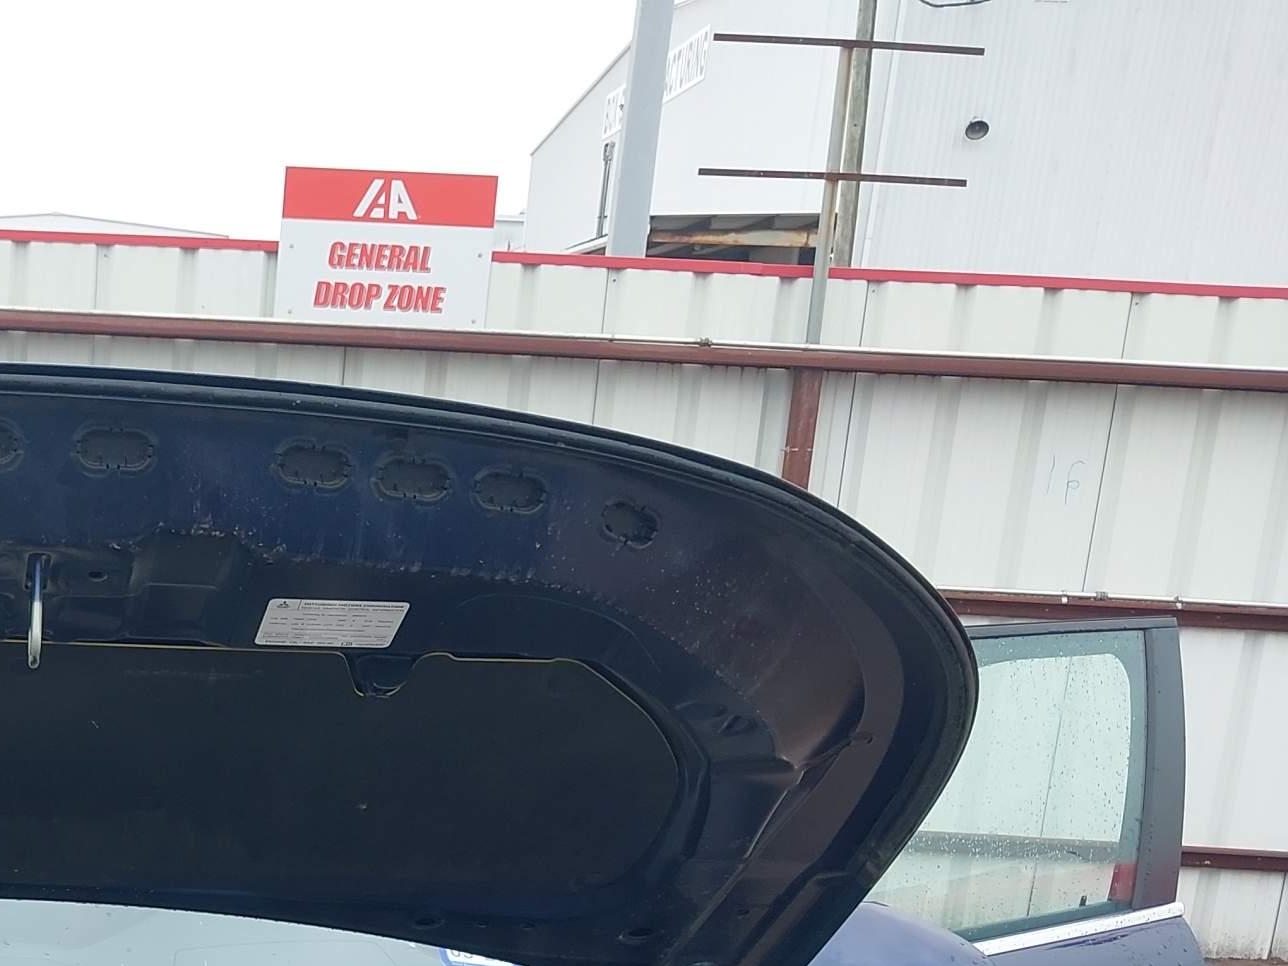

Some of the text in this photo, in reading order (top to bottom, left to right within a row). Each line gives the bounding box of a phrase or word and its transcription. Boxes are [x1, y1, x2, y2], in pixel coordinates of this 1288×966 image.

[328, 241, 432, 273] GENERAL
[313, 281, 447, 313] DROP ZONE
